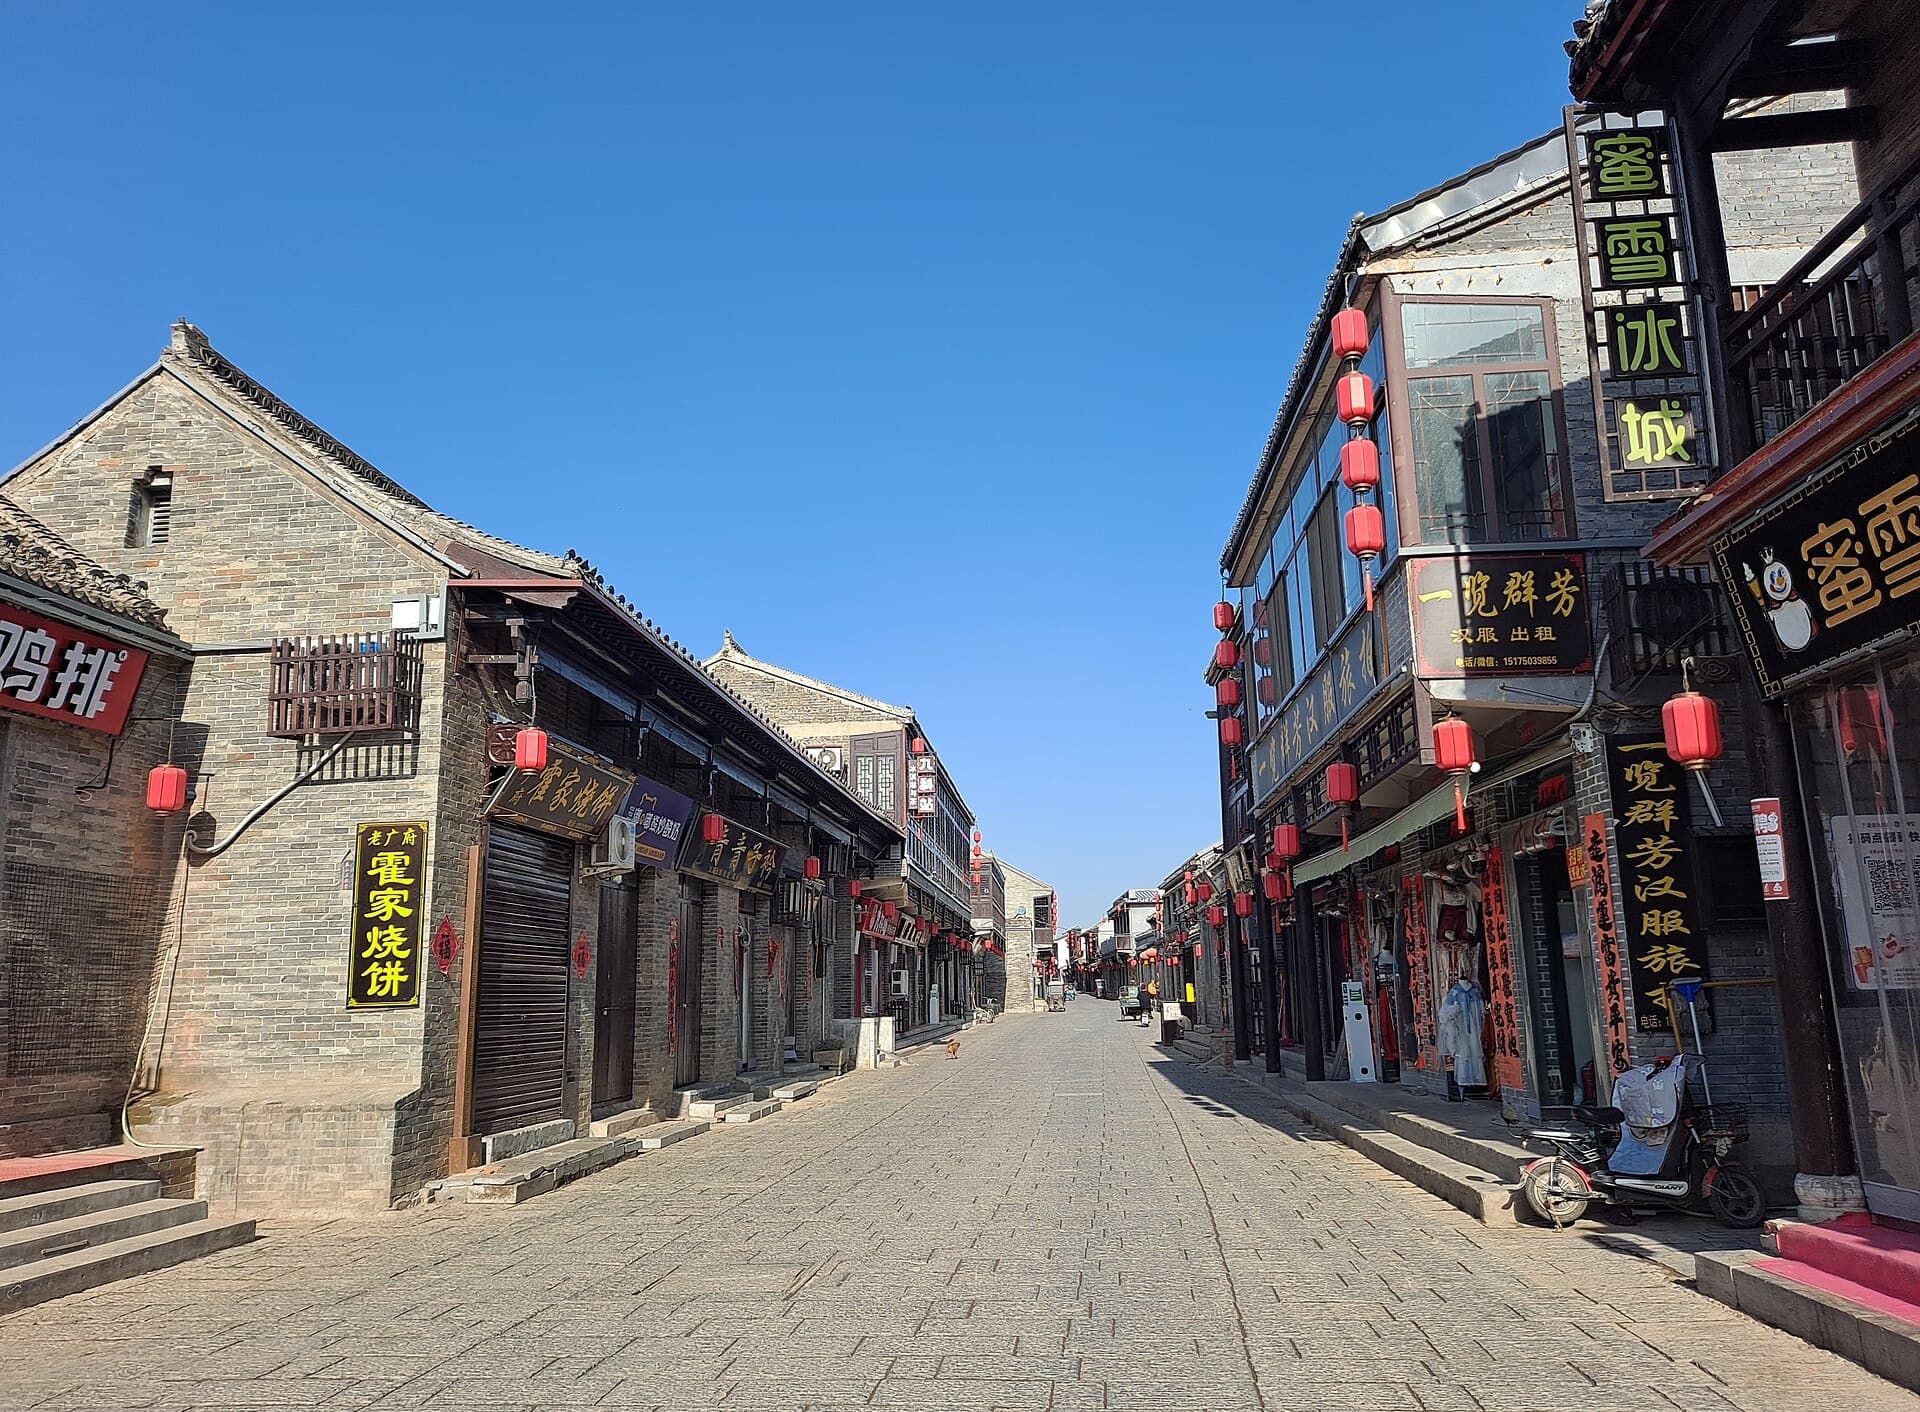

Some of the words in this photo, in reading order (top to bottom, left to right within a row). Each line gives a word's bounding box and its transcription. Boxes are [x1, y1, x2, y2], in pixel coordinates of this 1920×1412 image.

[1593, 133, 1691, 465] 蜜雪冰城
[1418, 570, 1581, 618] 一览群芳
[1801, 474, 1920, 629] 蜜雪
[1450, 627, 1499, 645] 汉服
[1511, 625, 1557, 642] 出租
[367, 828, 418, 847] 老广府
[361, 851, 415, 997] 霍家烧饼
